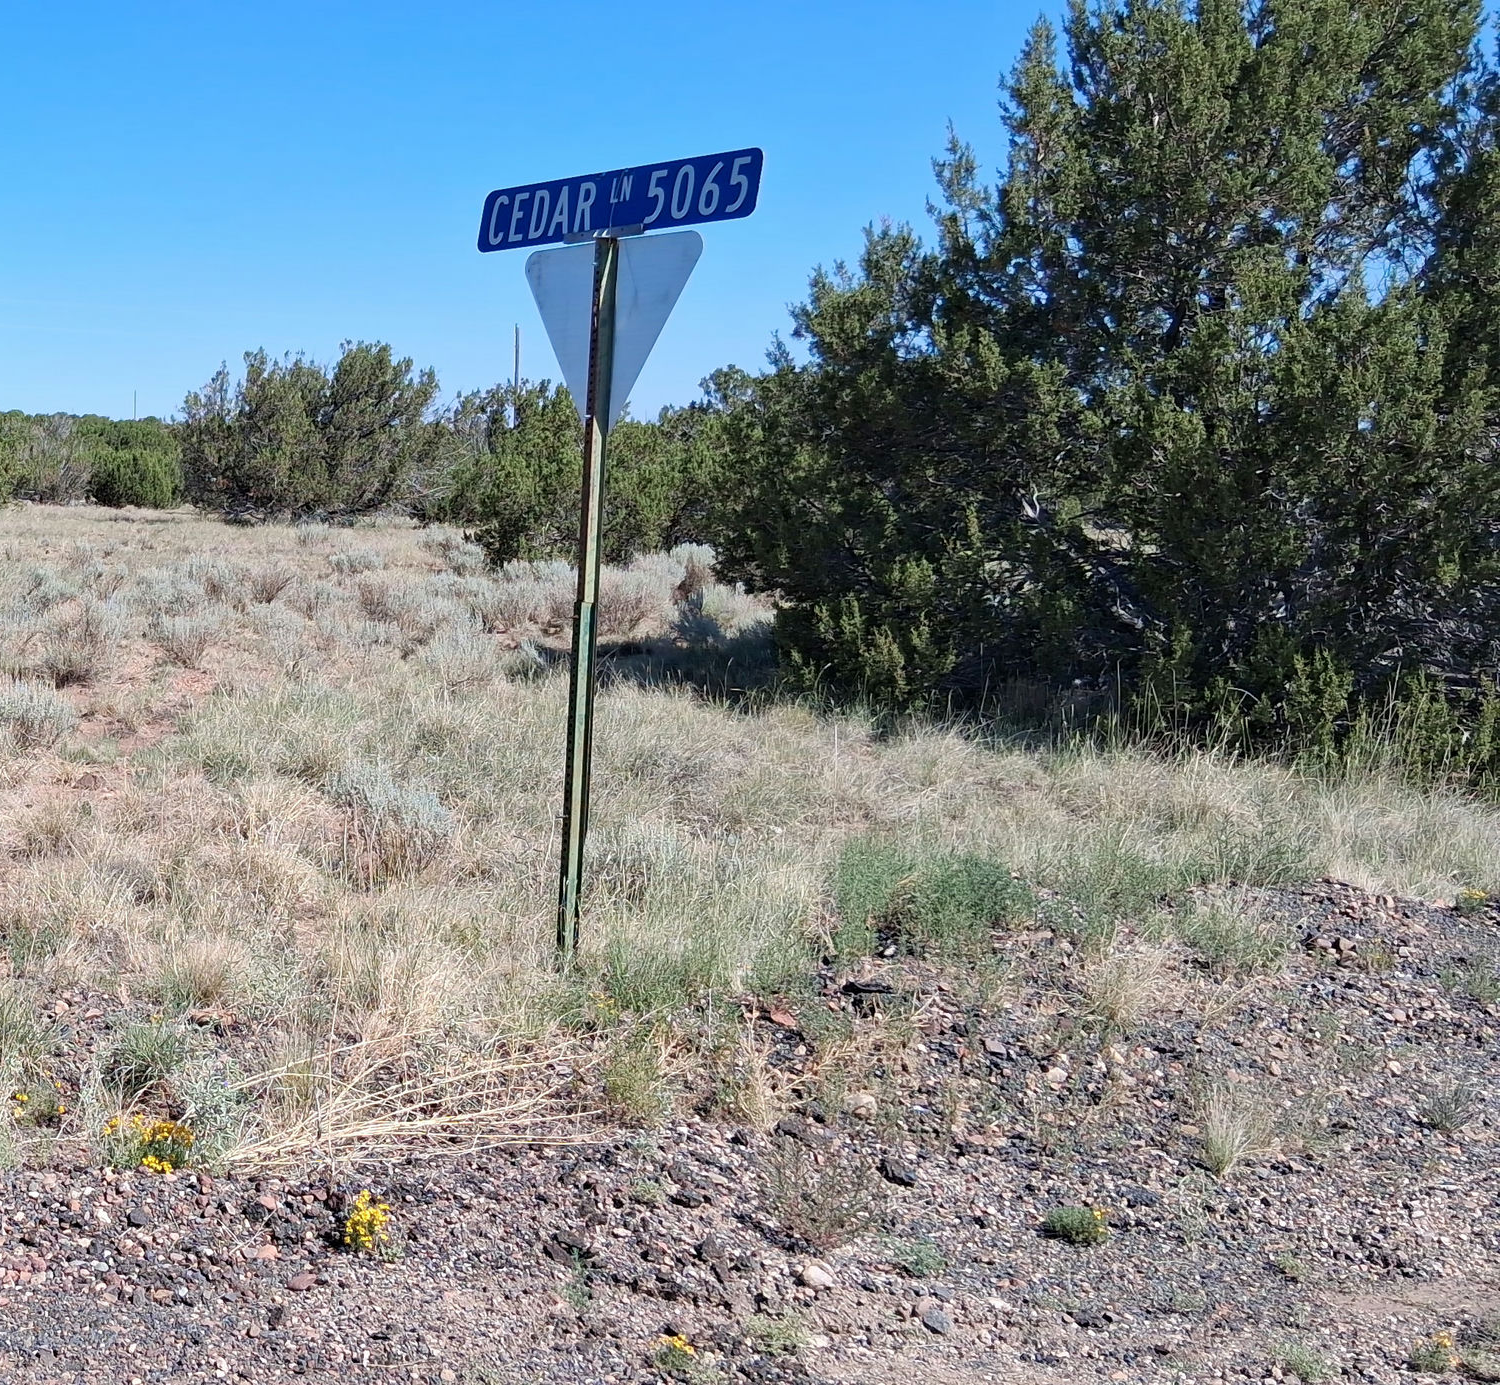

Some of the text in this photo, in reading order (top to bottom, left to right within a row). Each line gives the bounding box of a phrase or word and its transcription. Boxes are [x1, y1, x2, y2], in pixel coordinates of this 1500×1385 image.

[488, 156, 752, 246] CEDAR LN 5065
